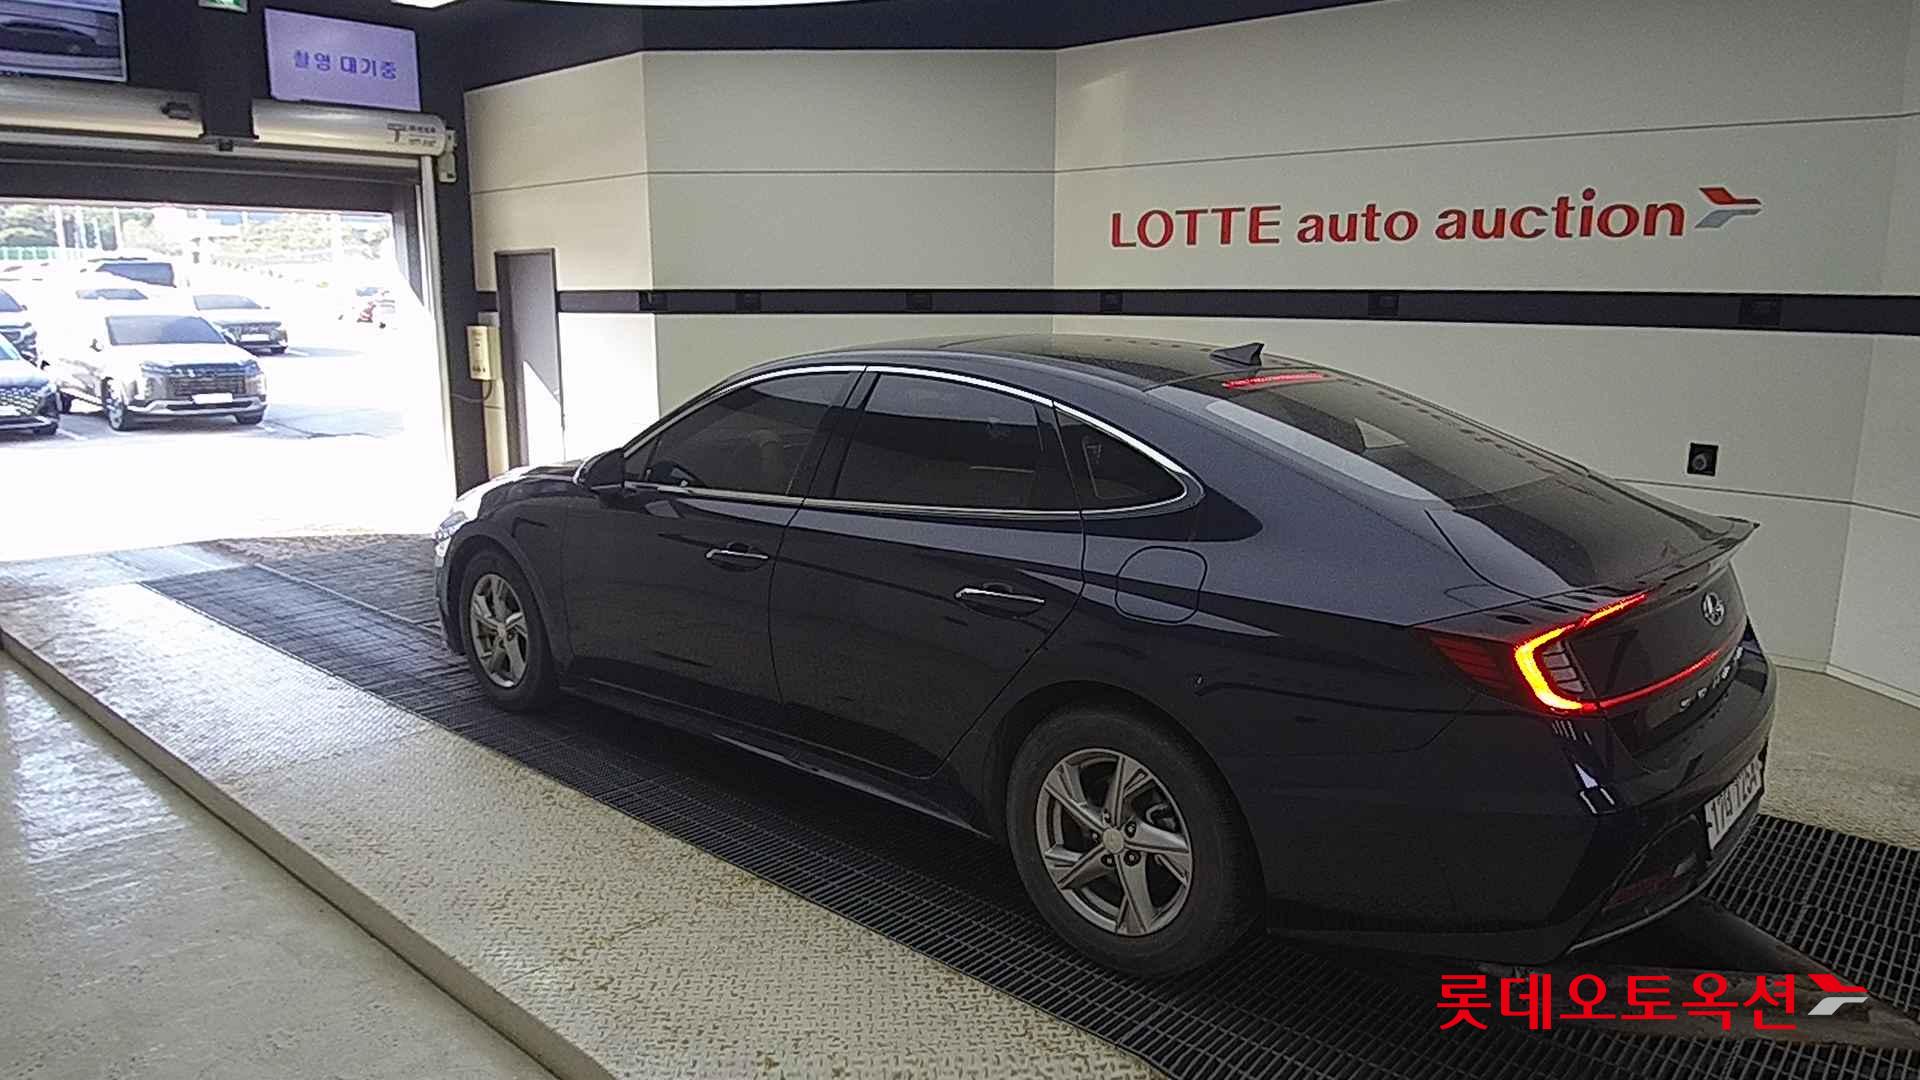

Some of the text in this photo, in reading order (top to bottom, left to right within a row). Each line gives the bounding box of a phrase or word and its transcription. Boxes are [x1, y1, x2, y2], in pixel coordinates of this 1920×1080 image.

[340, 55, 397, 79] 대기중
[1110, 187, 1686, 248] LOTTE auto auction
